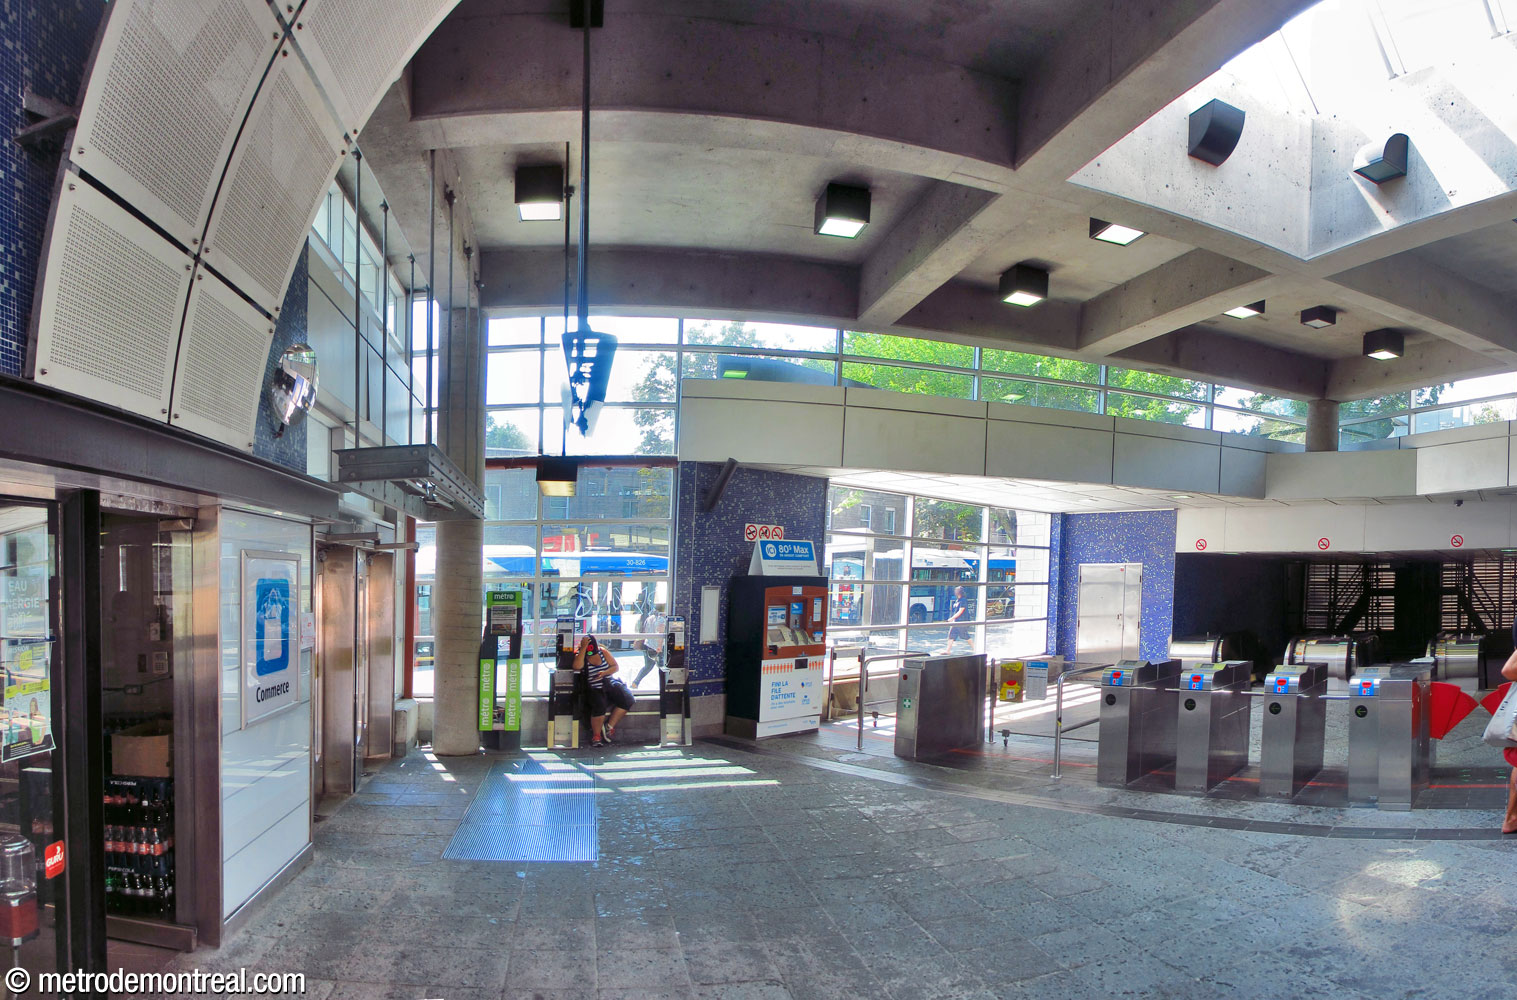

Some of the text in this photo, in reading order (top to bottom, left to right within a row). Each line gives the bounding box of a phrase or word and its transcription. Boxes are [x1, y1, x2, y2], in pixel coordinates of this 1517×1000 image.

[793, 545, 809, 554] Max
[482, 662, 491, 691] métro
[509, 662, 518, 691] métro
[256, 681, 290, 703] Commerce
[481, 698, 490, 726] métro
[507, 698, 516, 726] métro
[46, 850, 64, 867] GURU
